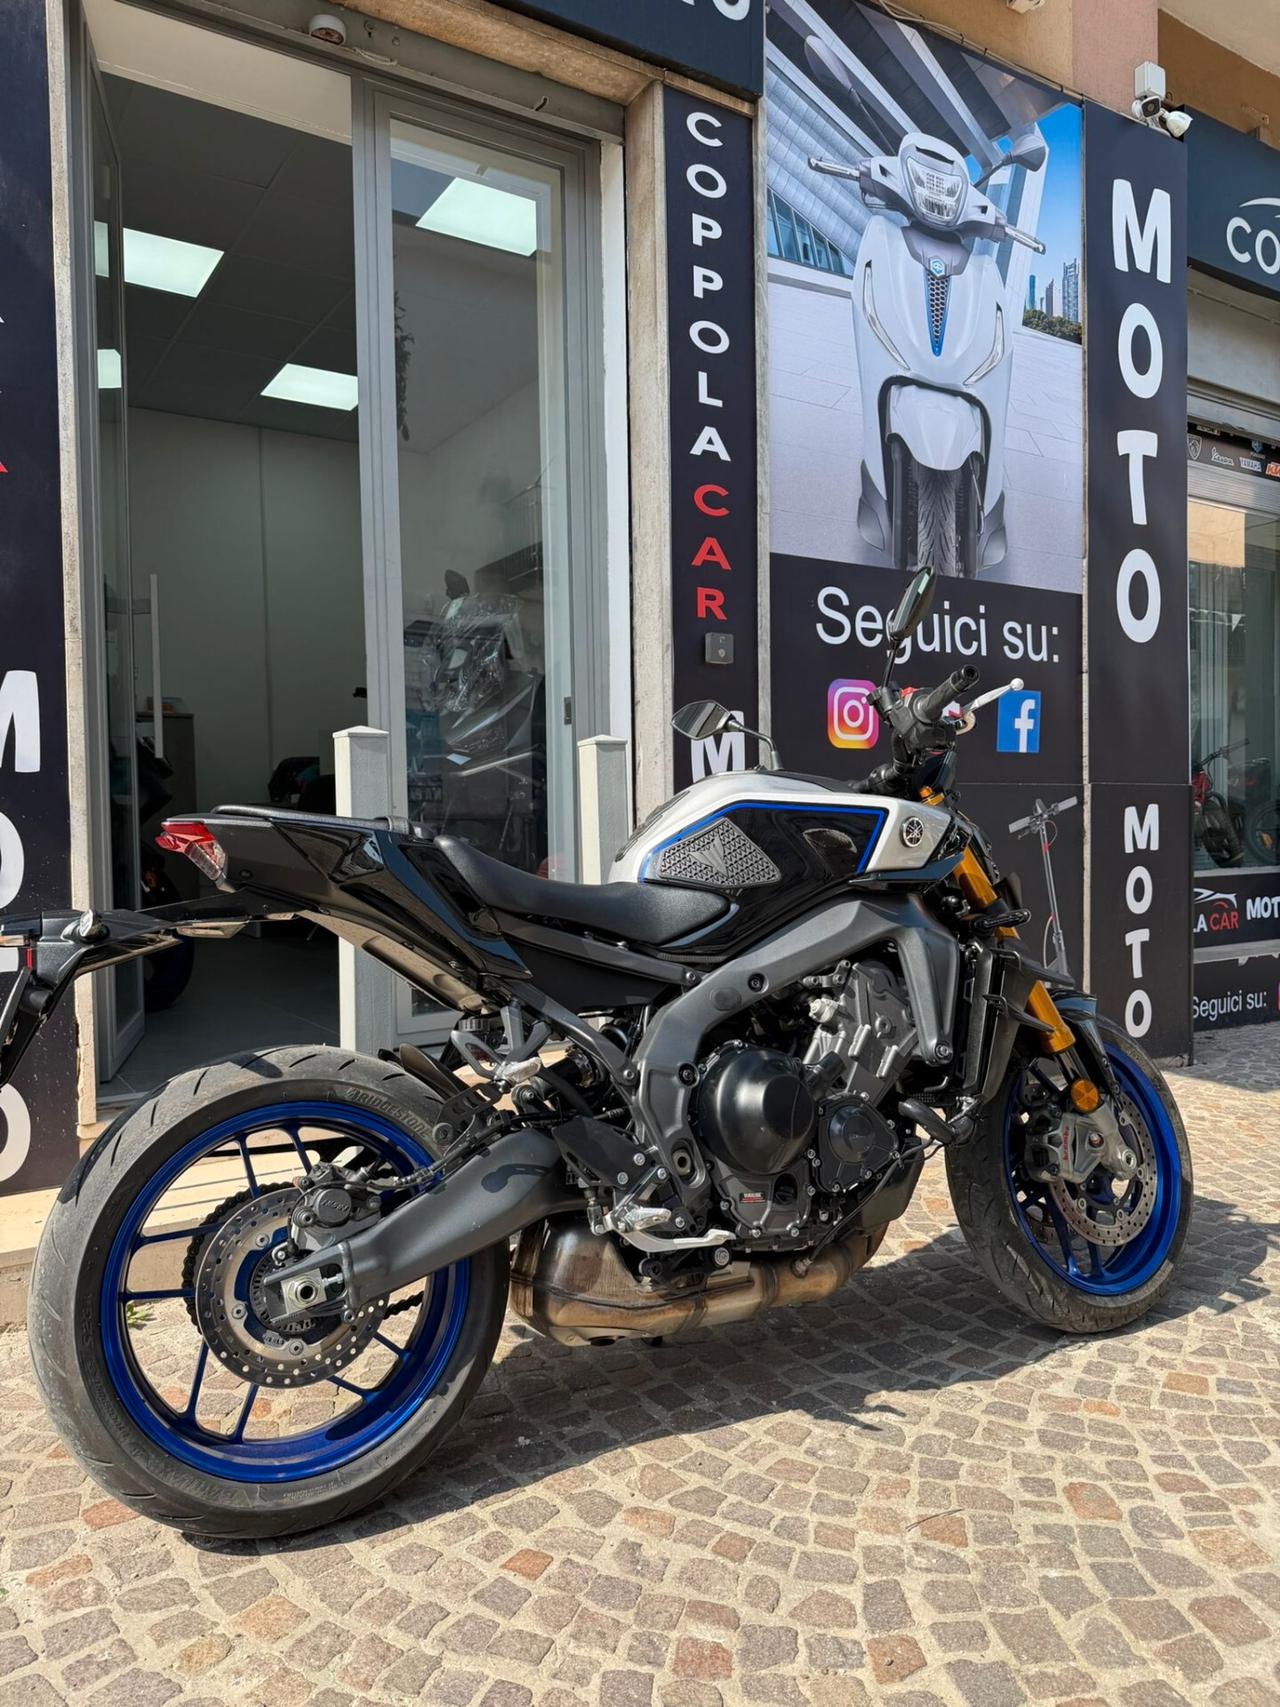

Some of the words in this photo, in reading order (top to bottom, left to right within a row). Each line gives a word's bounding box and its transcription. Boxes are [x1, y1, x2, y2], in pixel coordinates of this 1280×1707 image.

[1112, 179, 1172, 644] MOTO
[1002, 620, 1059, 664] su:
[1123, 803, 1159, 1039] MOTO
[1209, 911, 1239, 932] CAR
[1246, 992, 1267, 1009] su:
